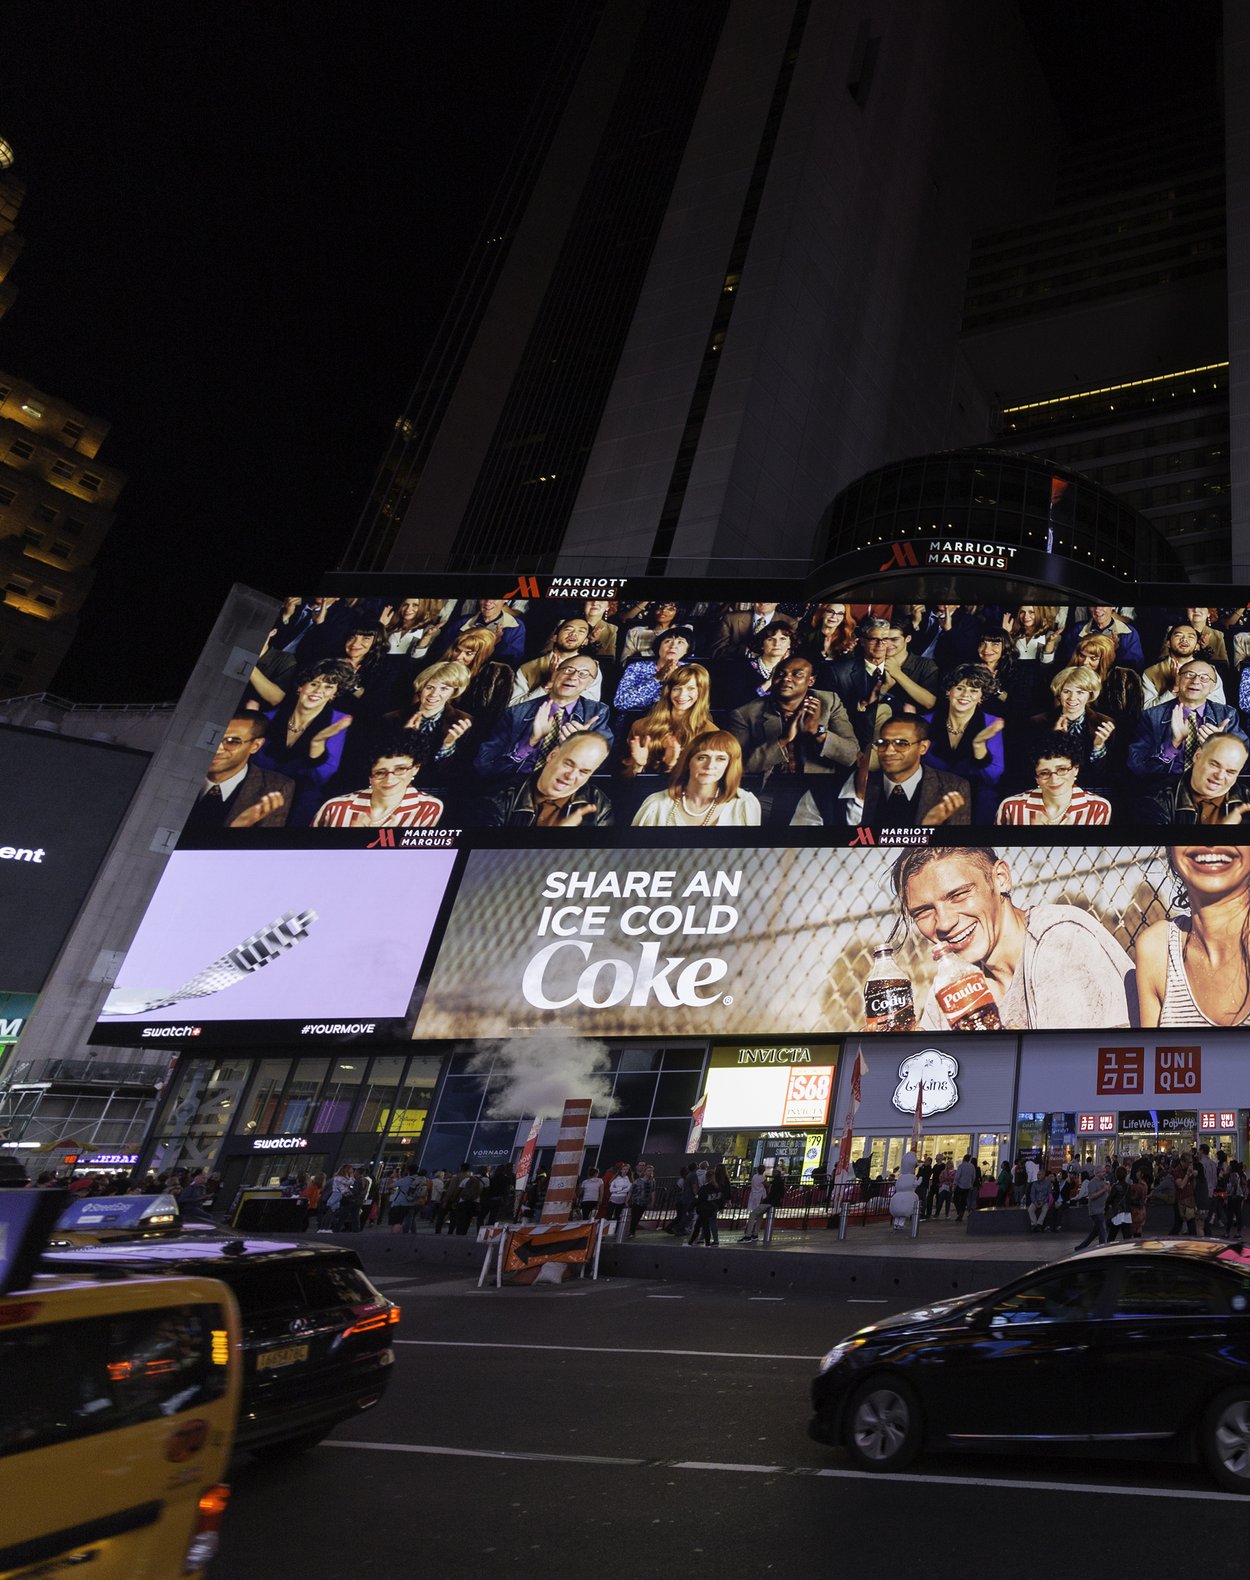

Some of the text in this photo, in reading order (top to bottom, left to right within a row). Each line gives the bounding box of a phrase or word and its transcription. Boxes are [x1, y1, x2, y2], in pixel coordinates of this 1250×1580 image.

[929, 540, 1017, 558] MARRIOTT
[926, 551, 1008, 570] MARQUIS
[552, 576, 628, 589] MARRIOTT
[547, 588, 617, 599] MARQUIS
[403, 829, 462, 837] MARRIOTT
[881, 827, 935, 836] MARRIOTT
[401, 837, 455, 847] MARQUIS
[879, 836, 930, 845] MARQUIS
[541, 870, 742, 899] SHARE AN
[537, 905, 739, 936] ICE COLD
[521, 939, 729, 1010] Coke
[943, 982, 985, 1009] Paula
[871, 996, 906, 1011] Cody
[142, 1026, 193, 1038] swatch
[301, 1023, 375, 1035] #YOURMOVE
[738, 1048, 811, 1063] INVICTA
[1160, 1052, 1193, 1069] UNI
[1159, 1071, 1196, 1091] QLO
[1099, 1123, 1113, 1131] QLO
[1220, 1120, 1234, 1128] QLO
[253, 1137, 299, 1149] swatch
